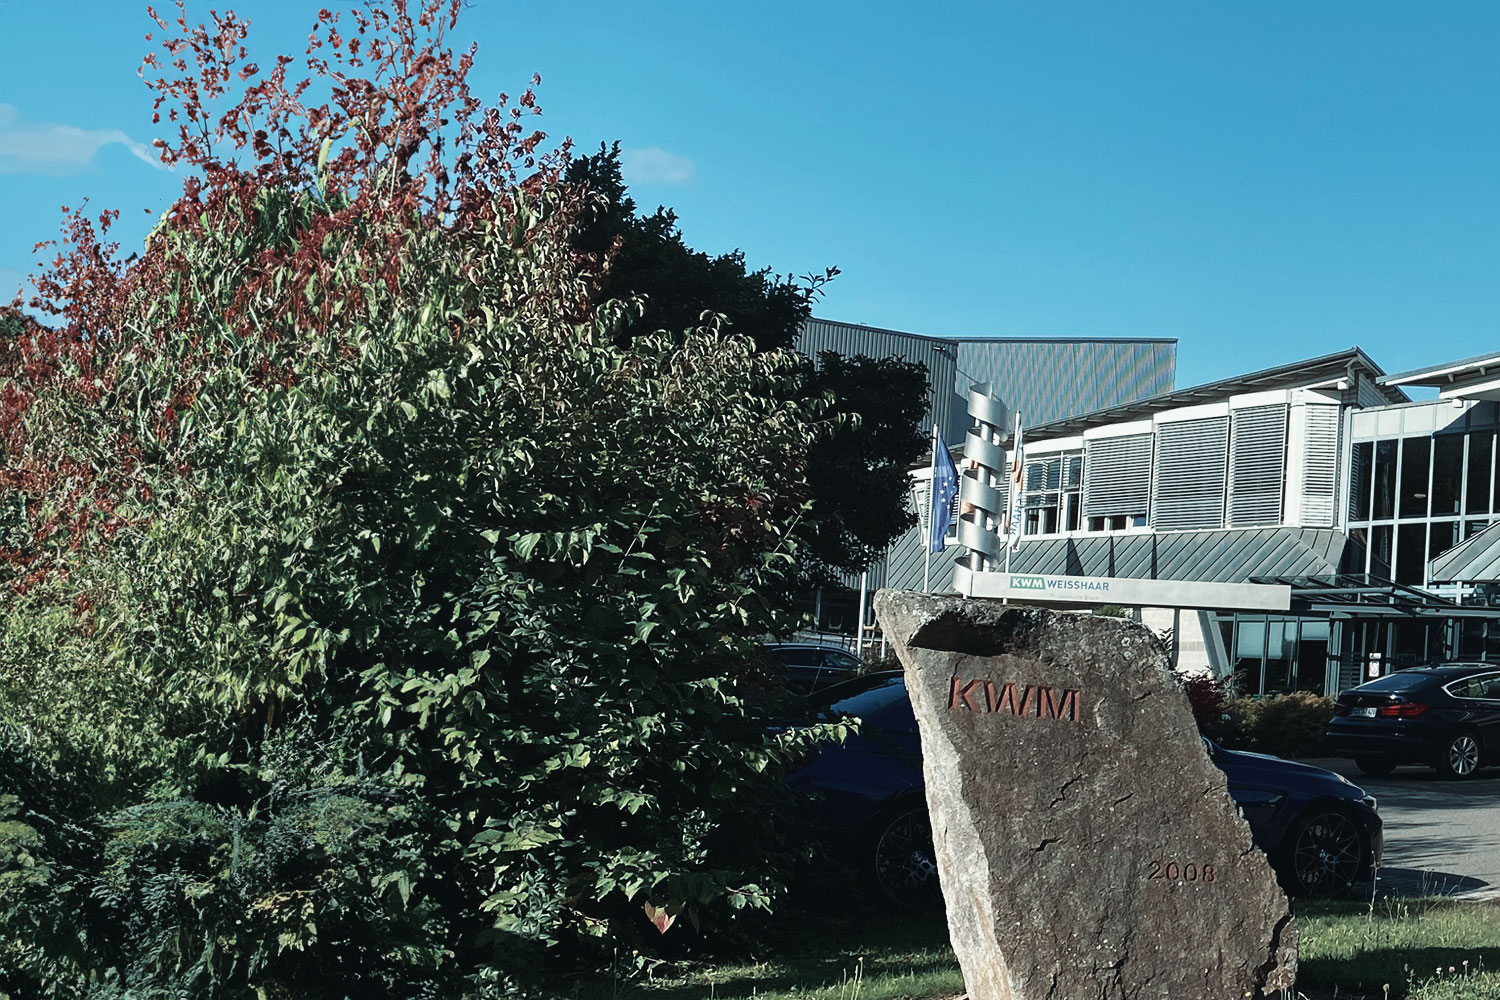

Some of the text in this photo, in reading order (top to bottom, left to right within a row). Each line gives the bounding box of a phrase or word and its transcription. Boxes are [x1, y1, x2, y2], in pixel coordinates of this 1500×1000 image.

[1012, 577, 1110, 591] KWM WEISSHAAR
[949, 676, 1080, 721] KWM
[1148, 860, 1216, 883] 2008
